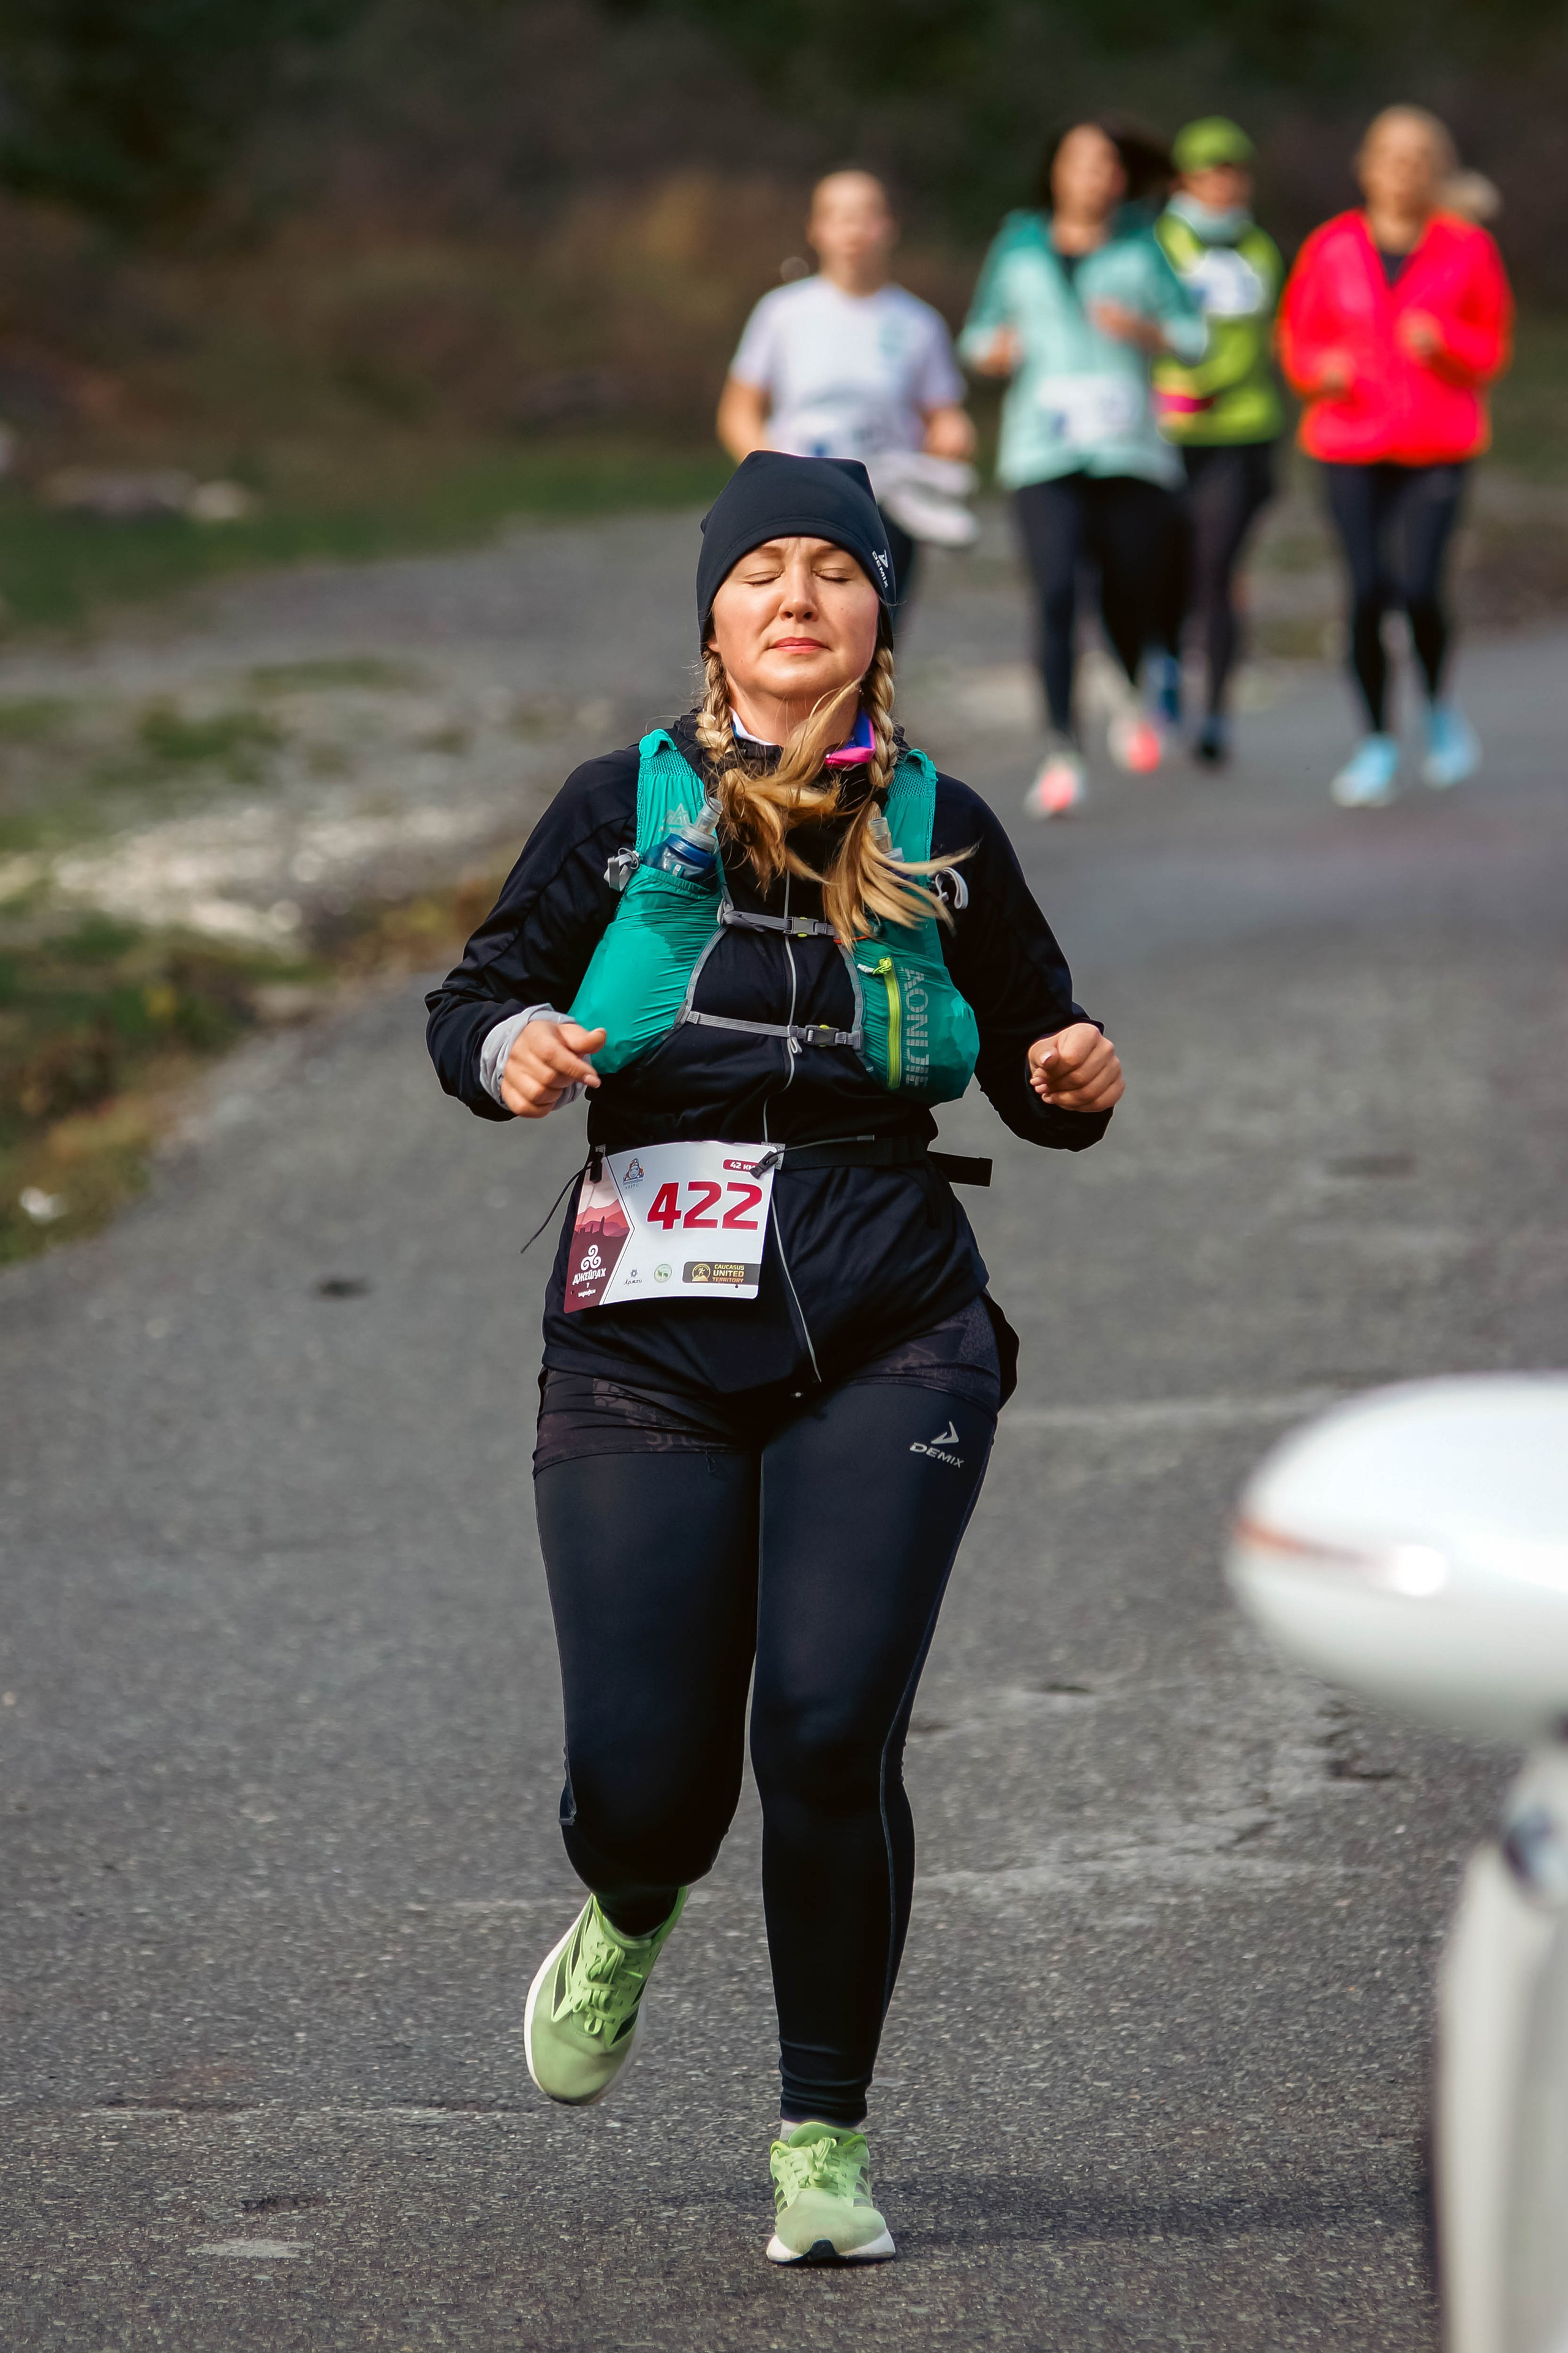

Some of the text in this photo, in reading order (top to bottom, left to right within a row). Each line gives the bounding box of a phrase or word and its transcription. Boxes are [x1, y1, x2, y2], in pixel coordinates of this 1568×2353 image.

[872, 550, 889, 588] DEMIX
[647, 1181, 763, 1230] 422
[910, 1442, 965, 1468] DEMIX
